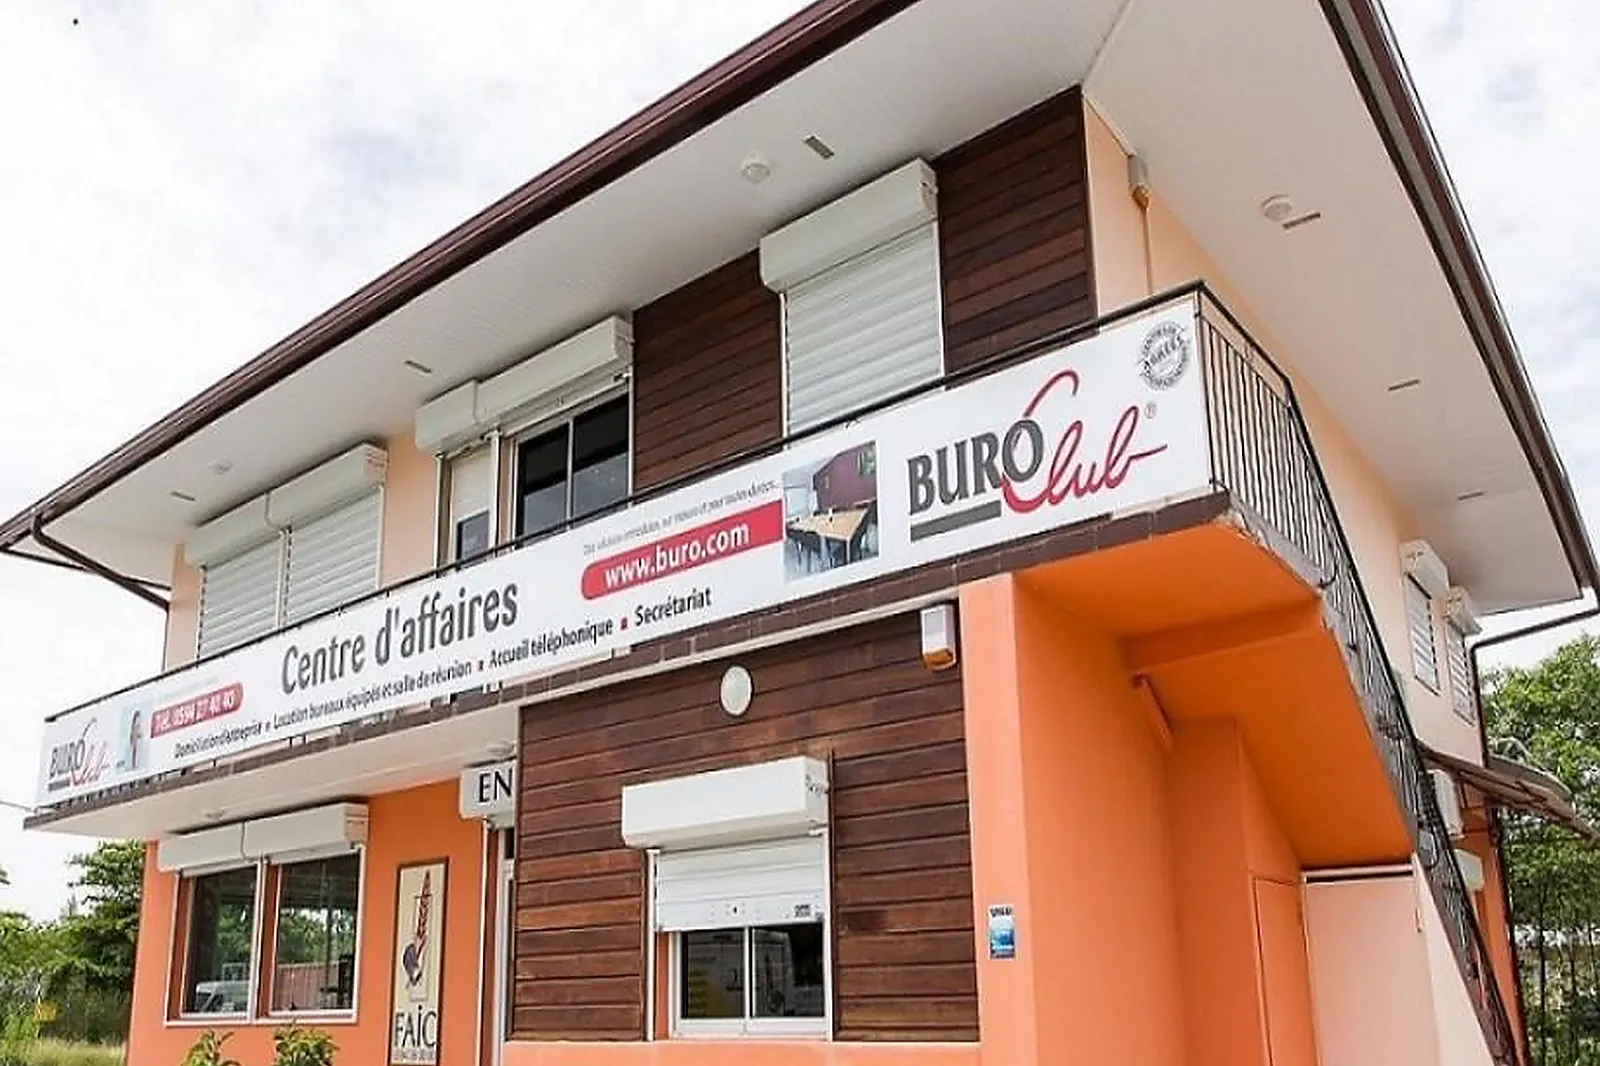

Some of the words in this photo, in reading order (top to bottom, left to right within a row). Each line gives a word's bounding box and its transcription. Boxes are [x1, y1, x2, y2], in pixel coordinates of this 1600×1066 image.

[906, 417, 1045, 516] BURO
[1001, 368, 1169, 514] Club
[603, 522, 750, 588] www.buro.com
[281, 634, 366, 694] Centre
[375, 583, 518, 666] d'affaires
[634, 586, 712, 627] Secrétariat
[479, 767, 513, 803] EN
